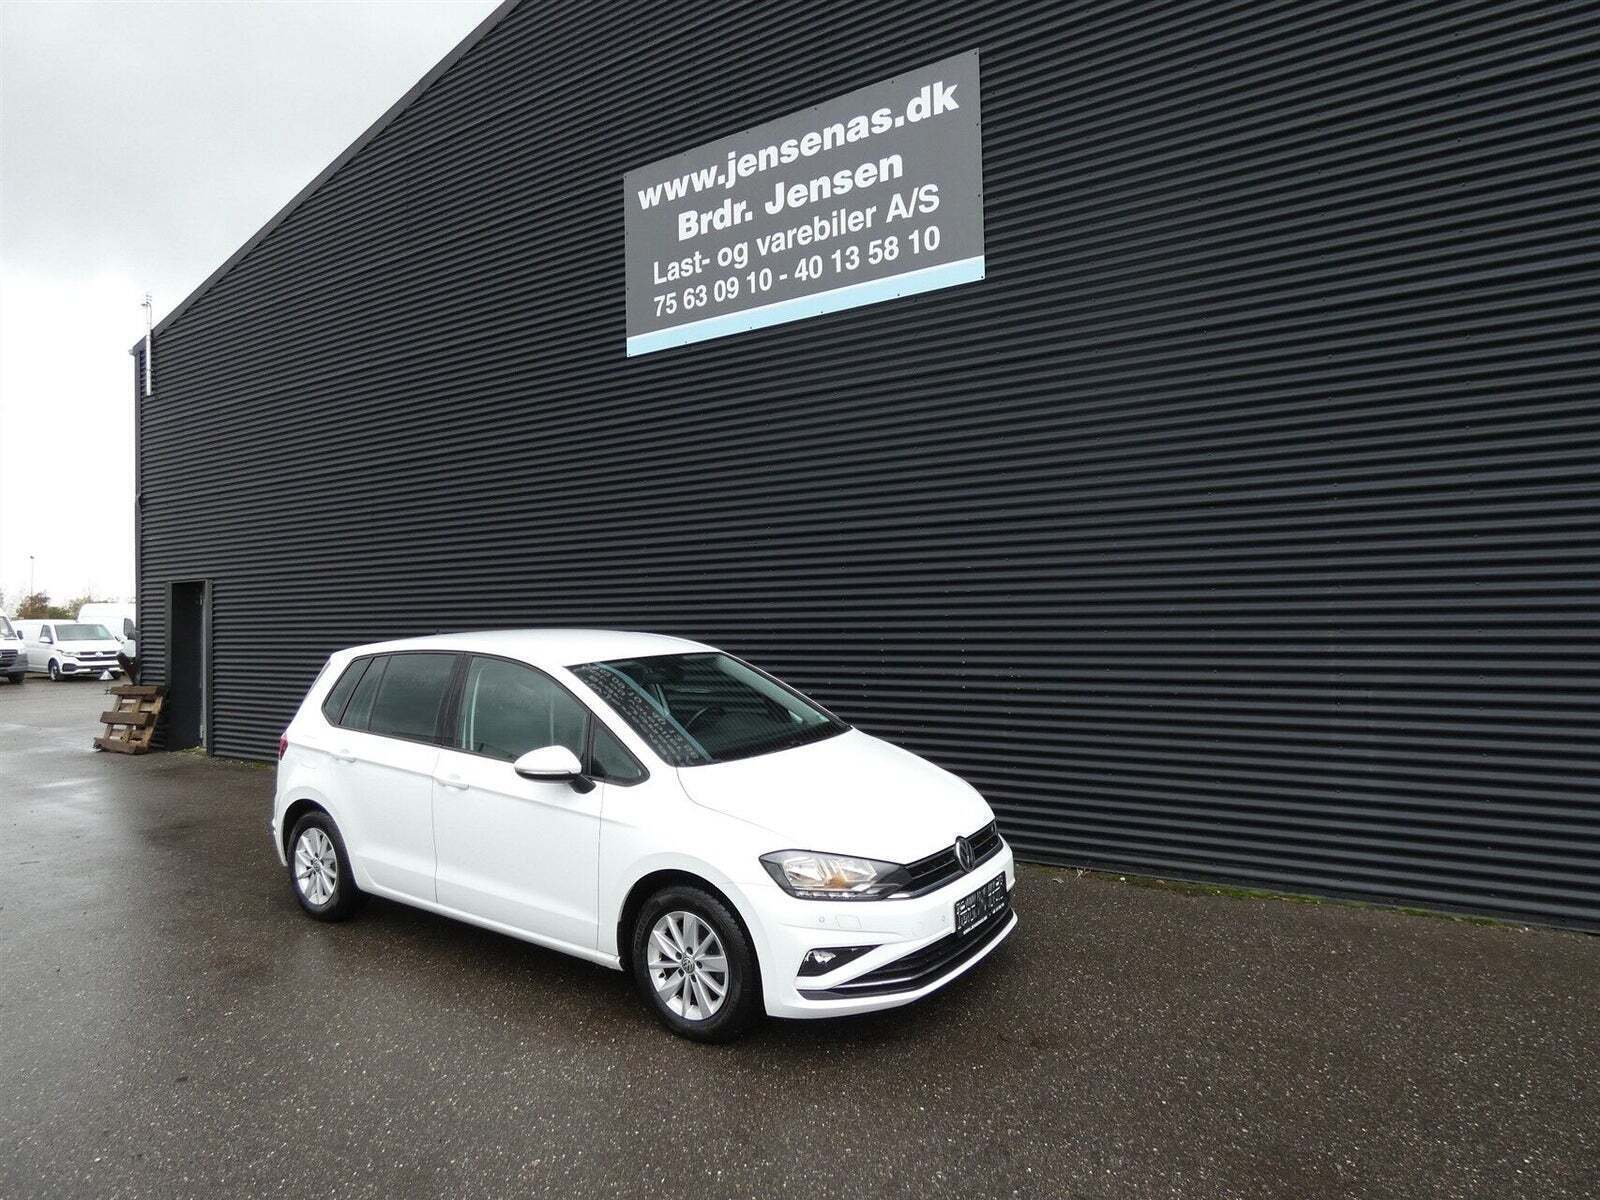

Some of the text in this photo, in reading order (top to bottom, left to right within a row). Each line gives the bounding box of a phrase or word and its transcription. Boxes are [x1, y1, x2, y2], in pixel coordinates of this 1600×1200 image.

[637, 81, 960, 211] www.jensenas.dk
[653, 183, 940, 285] Last- og varebiler A/S
[678, 153, 903, 242] Brdr. Jensen
[653, 291, 678, 317] 75
[683, 284, 708, 310] 63
[713, 276, 740, 303] 09
[746, 267, 773, 294] 10
[794, 254, 823, 282] 40
[831, 245, 860, 273] 13
[867, 235, 900, 265] 58
[908, 225, 941, 255] 10
